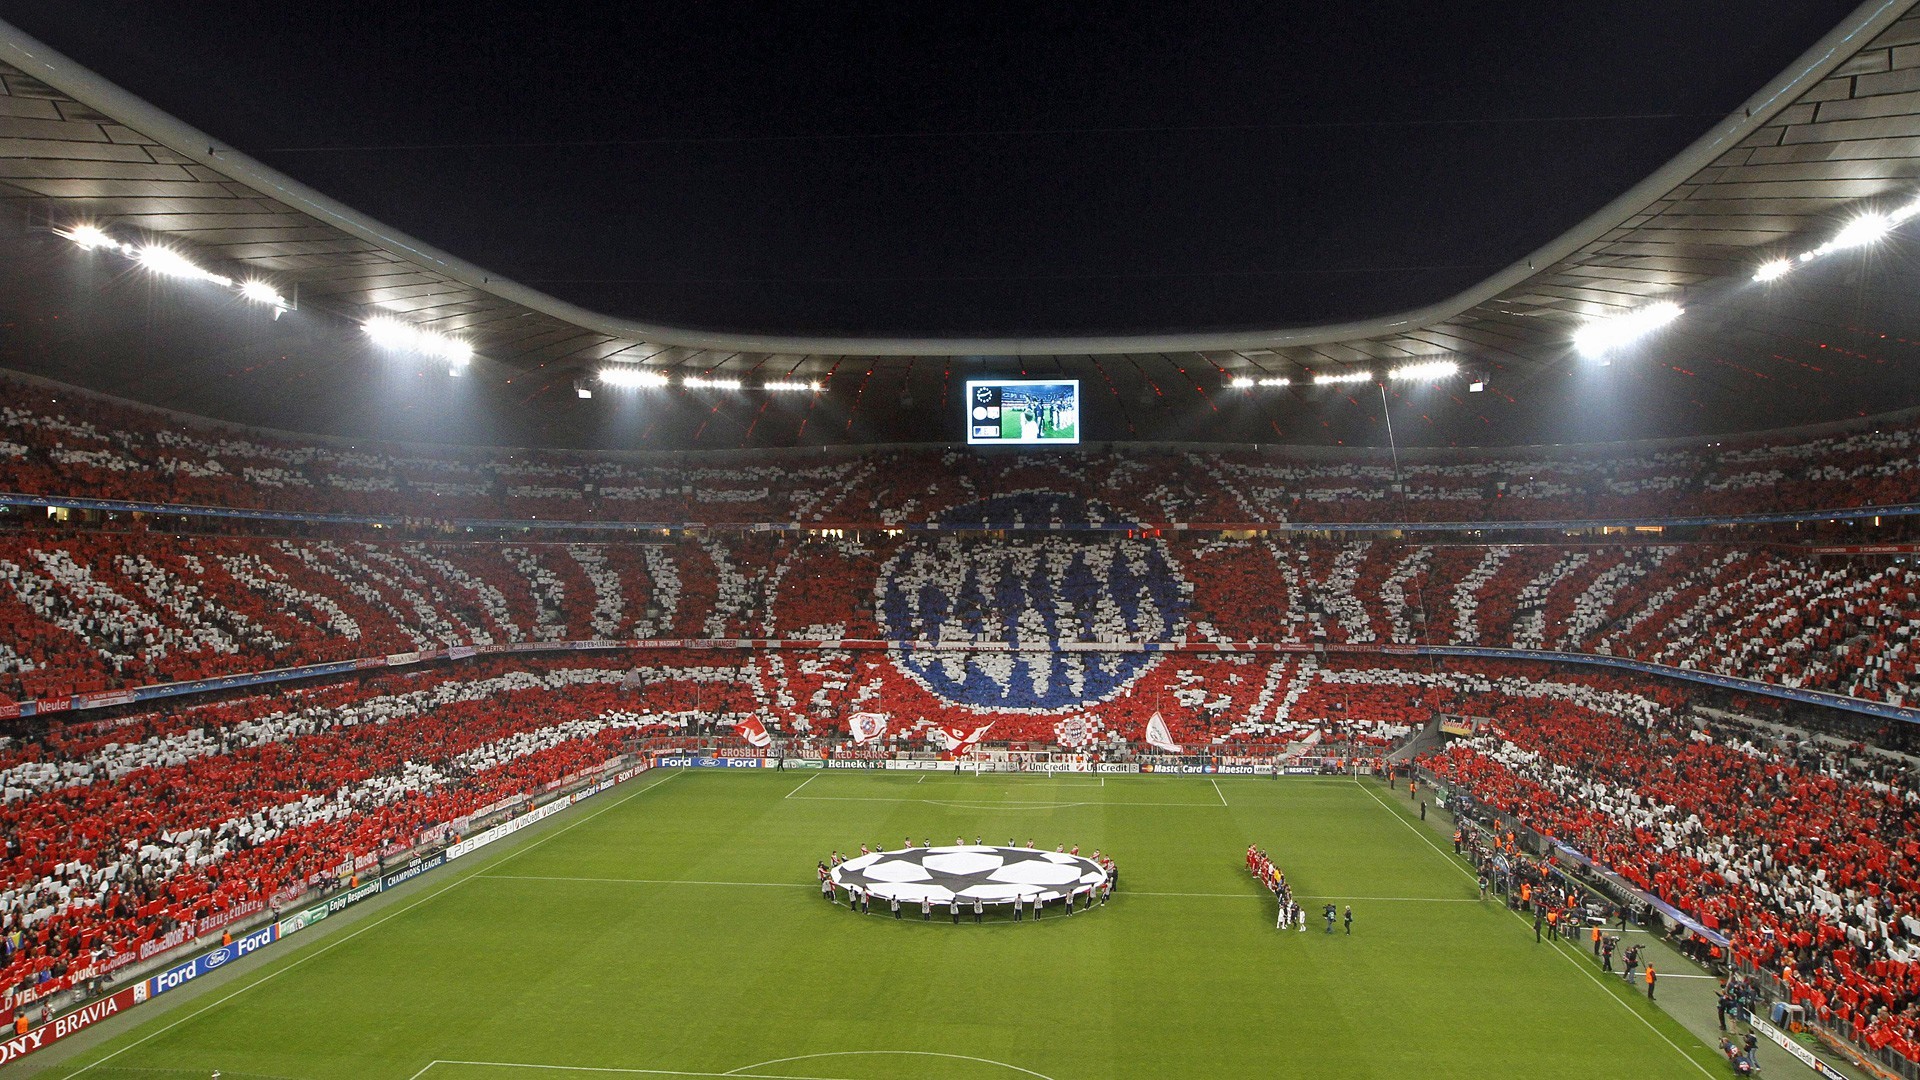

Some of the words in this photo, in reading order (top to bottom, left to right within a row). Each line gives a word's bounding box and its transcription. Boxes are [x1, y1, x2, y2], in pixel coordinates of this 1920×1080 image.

[38, 700, 70, 713] Neuler
[835, 750, 848, 759] RED
[854, 750, 891, 759] SHARKS
[661, 758, 692, 767] Ford
[726, 758, 757, 767] Ford
[1029, 762, 1070, 771] UniCredit
[1154, 765, 1203, 773] MasteCard
[1217, 765, 1253, 774] Maestro
[618, 769, 634, 783] SONY
[519, 811, 541, 827] UniCredit
[546, 799, 566, 816] UniCredit
[453, 840, 475, 857] PS3
[488, 828, 508, 842] PS3
[409, 857, 422, 868] UEFA
[387, 866, 421, 887] CHAMPIONS
[421, 855, 442, 872] LEAGUE
[329, 897, 347, 912] Enjoy
[347, 881, 380, 904] Responsibly
[157, 960, 197, 993] Ford
[237, 927, 271, 956] Ford
[0, 1027, 47, 1065] ONY
[55, 997, 118, 1039] BRAVIA
